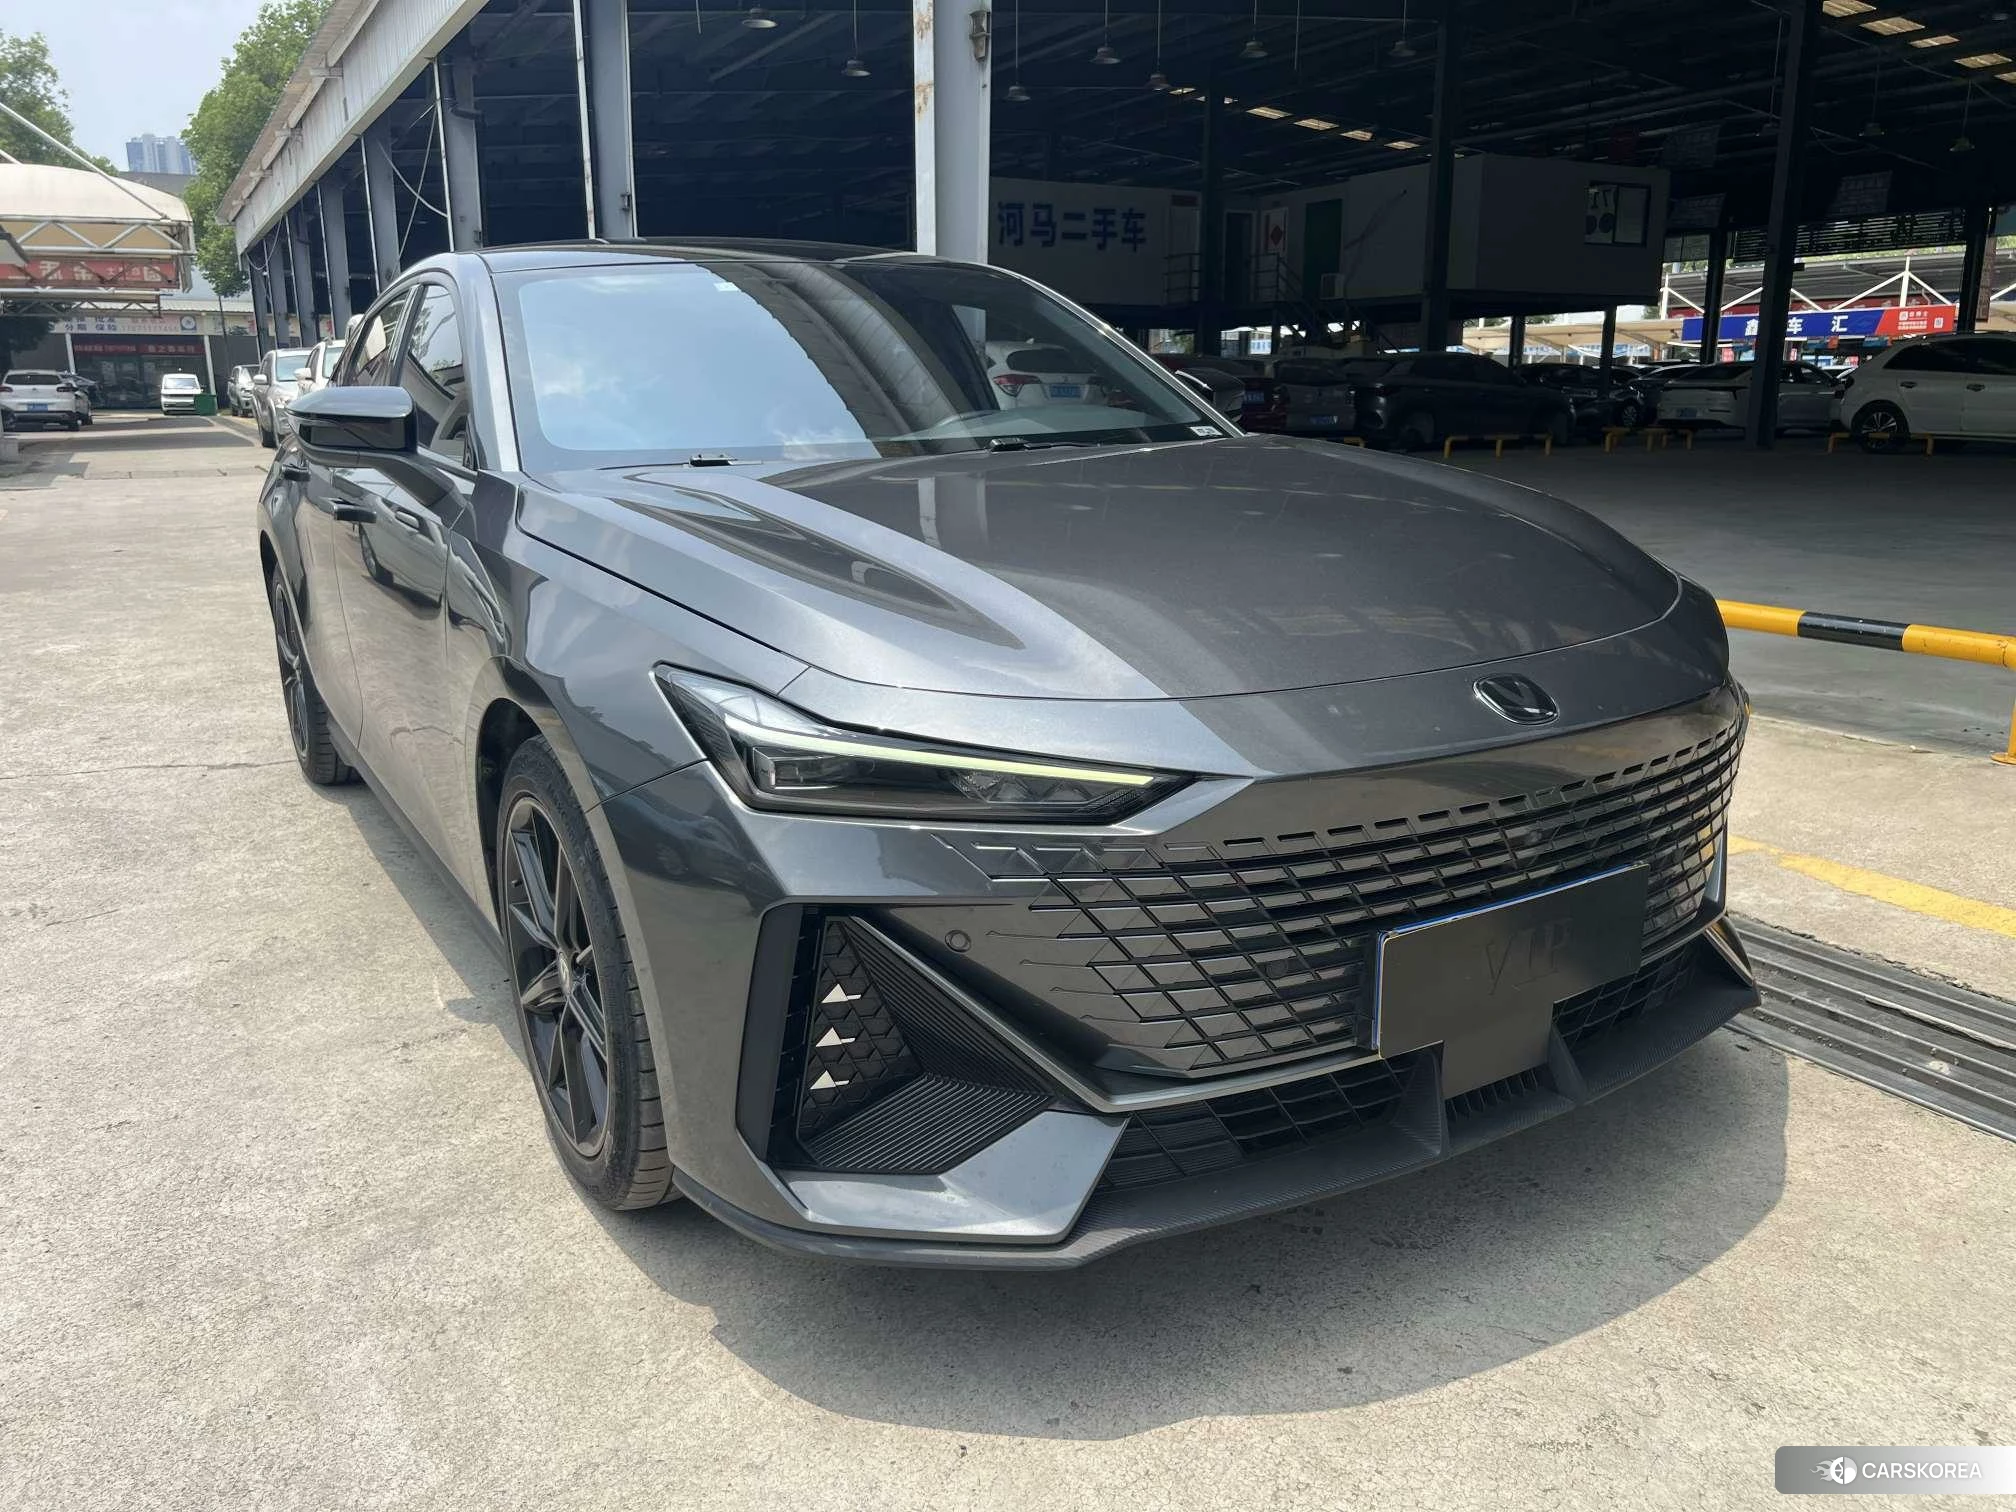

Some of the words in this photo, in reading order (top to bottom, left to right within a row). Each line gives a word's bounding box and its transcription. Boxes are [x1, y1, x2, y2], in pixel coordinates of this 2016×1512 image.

[998, 203, 1147, 252] 河马二手车
